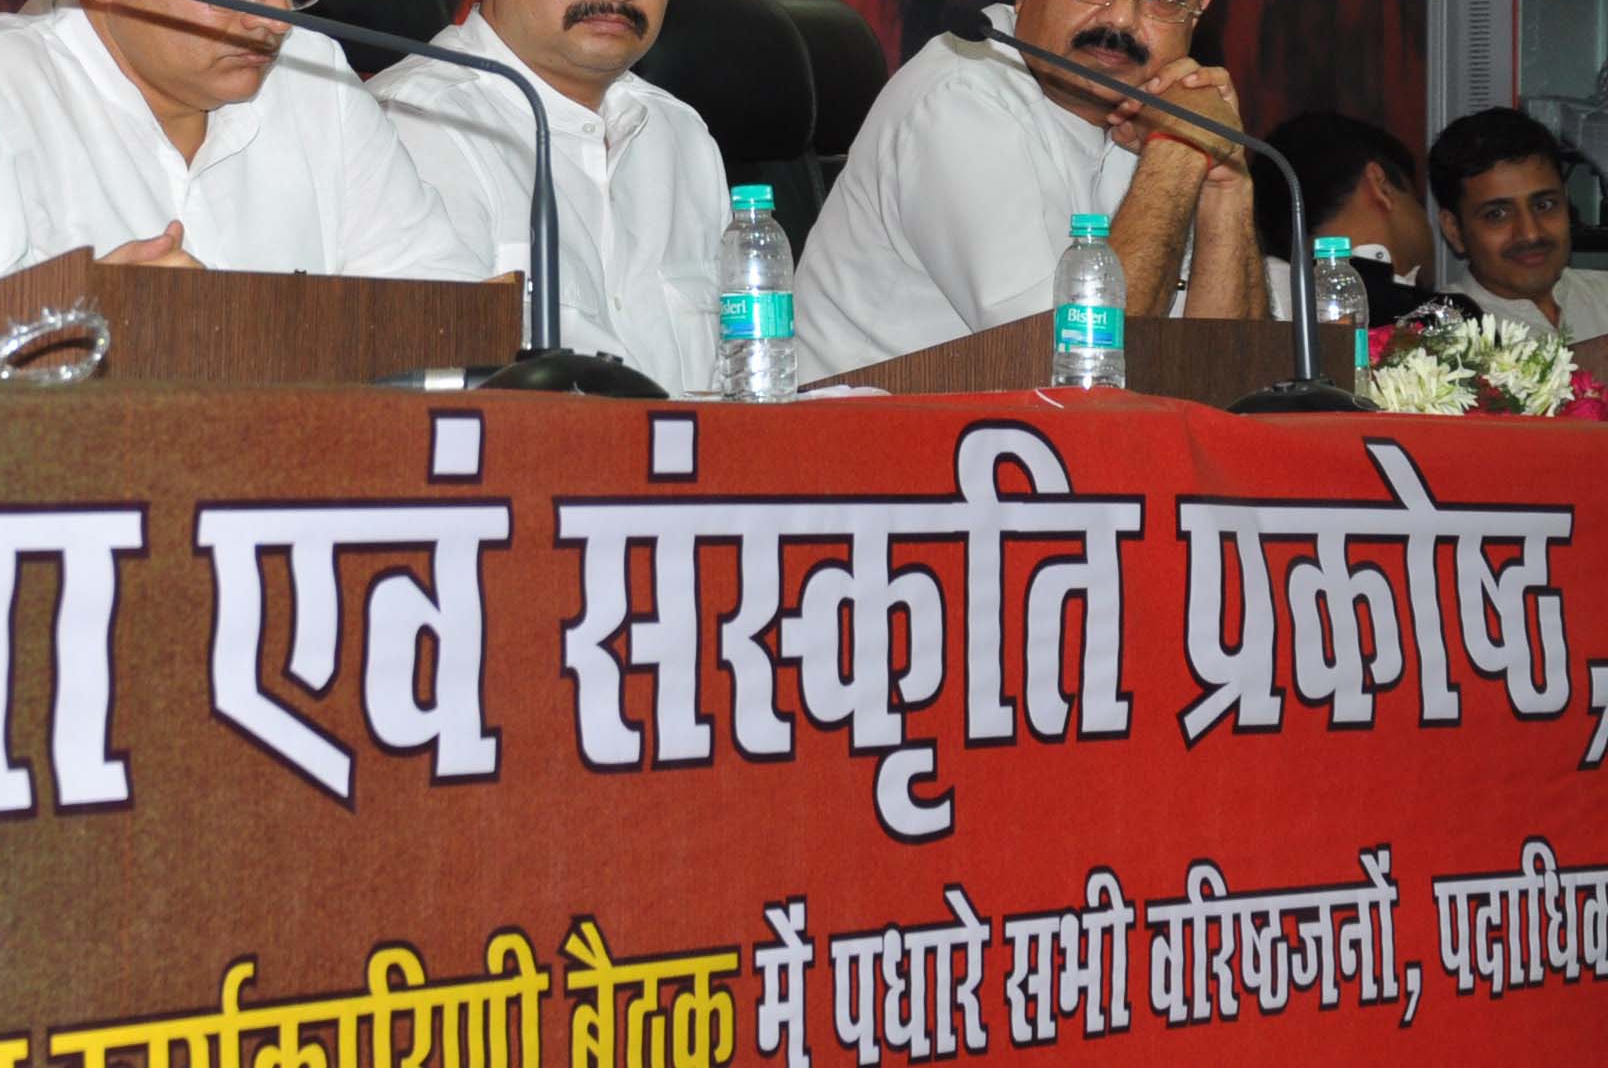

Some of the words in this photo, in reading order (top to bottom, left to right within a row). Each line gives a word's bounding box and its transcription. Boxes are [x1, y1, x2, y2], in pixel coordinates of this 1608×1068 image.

[1067, 307, 1107, 325] Biseri
[195, 411, 513, 812] एवं
[555, 412, 1144, 840] संस्कृति
[754, 895, 814, 1068] में
[830, 882, 992, 1068] पधारे
[1004, 864, 1135, 1048] सभी
